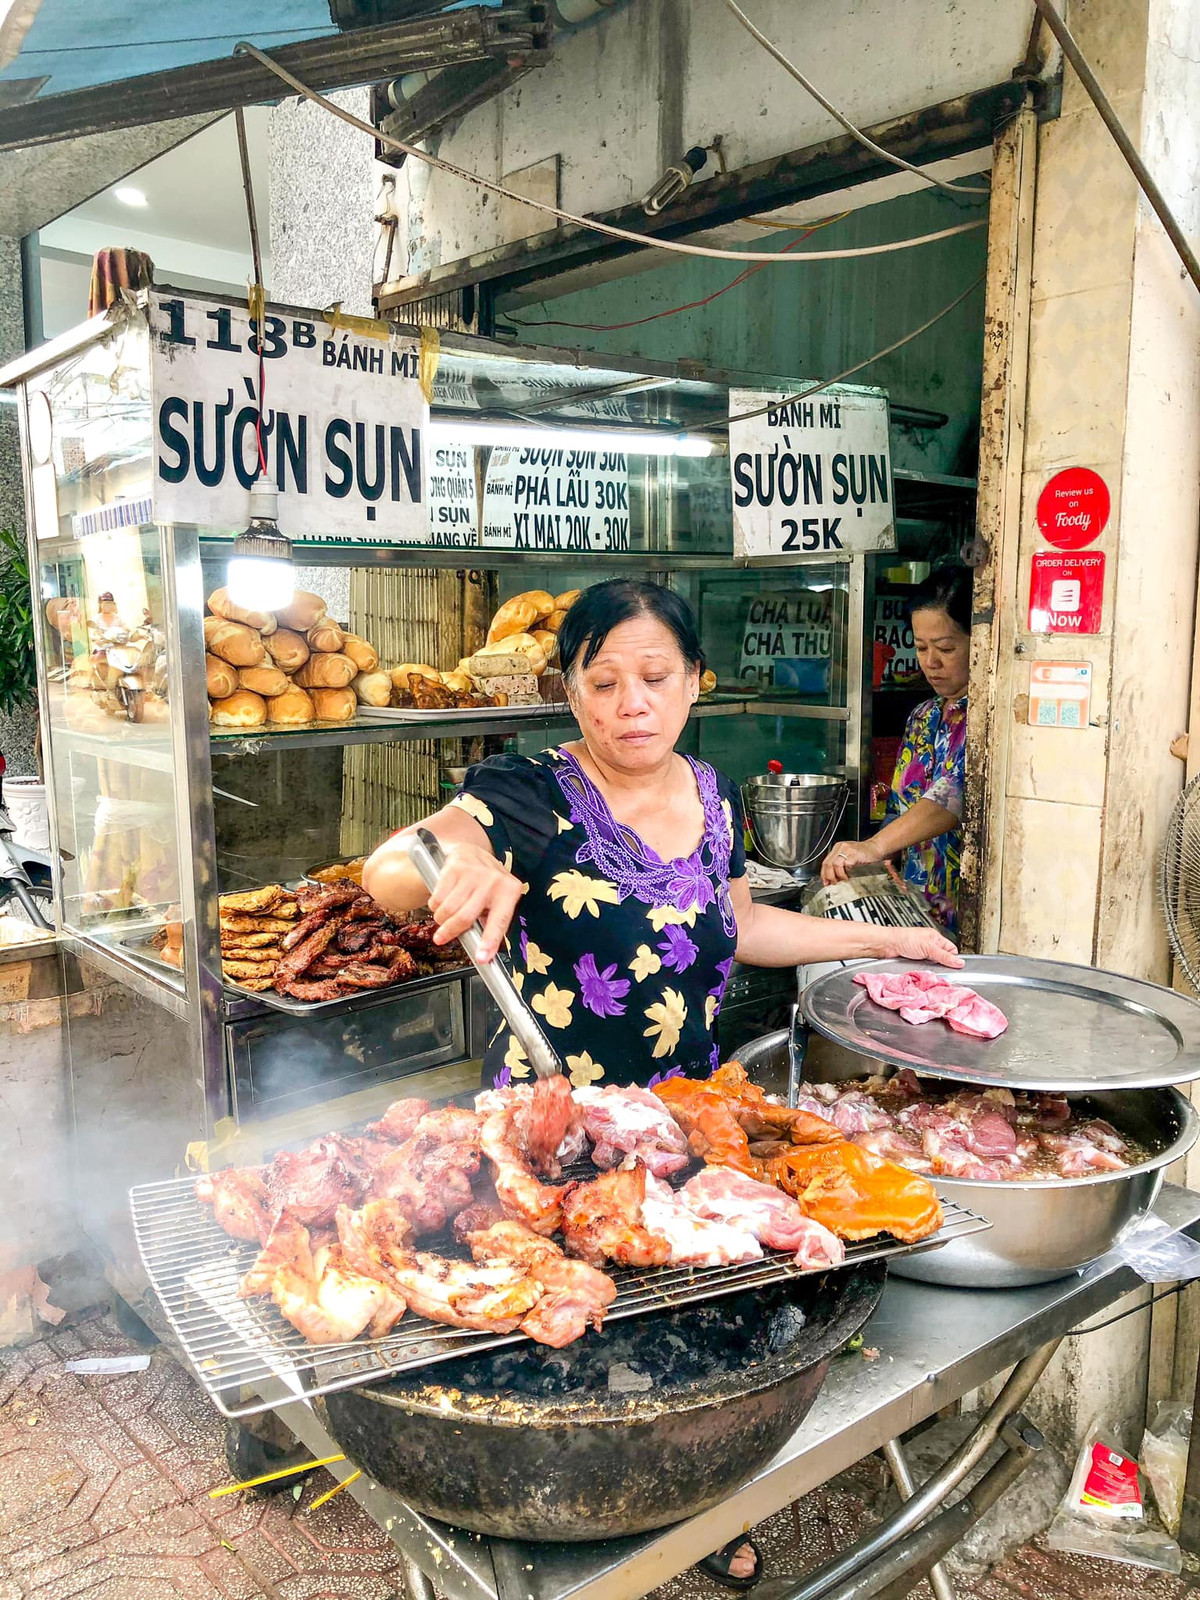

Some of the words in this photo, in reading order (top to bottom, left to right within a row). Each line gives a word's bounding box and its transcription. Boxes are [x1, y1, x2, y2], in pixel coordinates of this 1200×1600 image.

[322, 334, 384, 374] BÁNH
[391, 345, 421, 379] MÌ
[767, 394, 815, 428] BÁNH
[820, 397, 841, 428] MÌ
[158, 377, 308, 494] SƯỜN
[325, 418, 422, 521] SỤN
[515, 467, 551, 506] PHÁ
[595, 481, 628, 510] 30K
[734, 435, 823, 507] SƯỜN
[832, 453, 888, 517] SỤN
[1055, 488, 1082, 498] Review
[1084, 487, 1094, 496] us
[1069, 500, 1079, 508] on
[438, 506, 470, 527] SỤN
[484, 522, 502, 537] BÁNH
[503, 523, 511, 538] MÌ
[566, 515, 592, 549] 20K
[604, 516, 628, 550] 30K
[1055, 512, 1091, 531] Foody
[781, 518, 843, 551] 25K
[1036, 559, 1063, 567] ORDER
[1064, 558, 1101, 567] DELIVERY
[1047, 612, 1082, 627] Now
[744, 624, 786, 656] CHẢ
